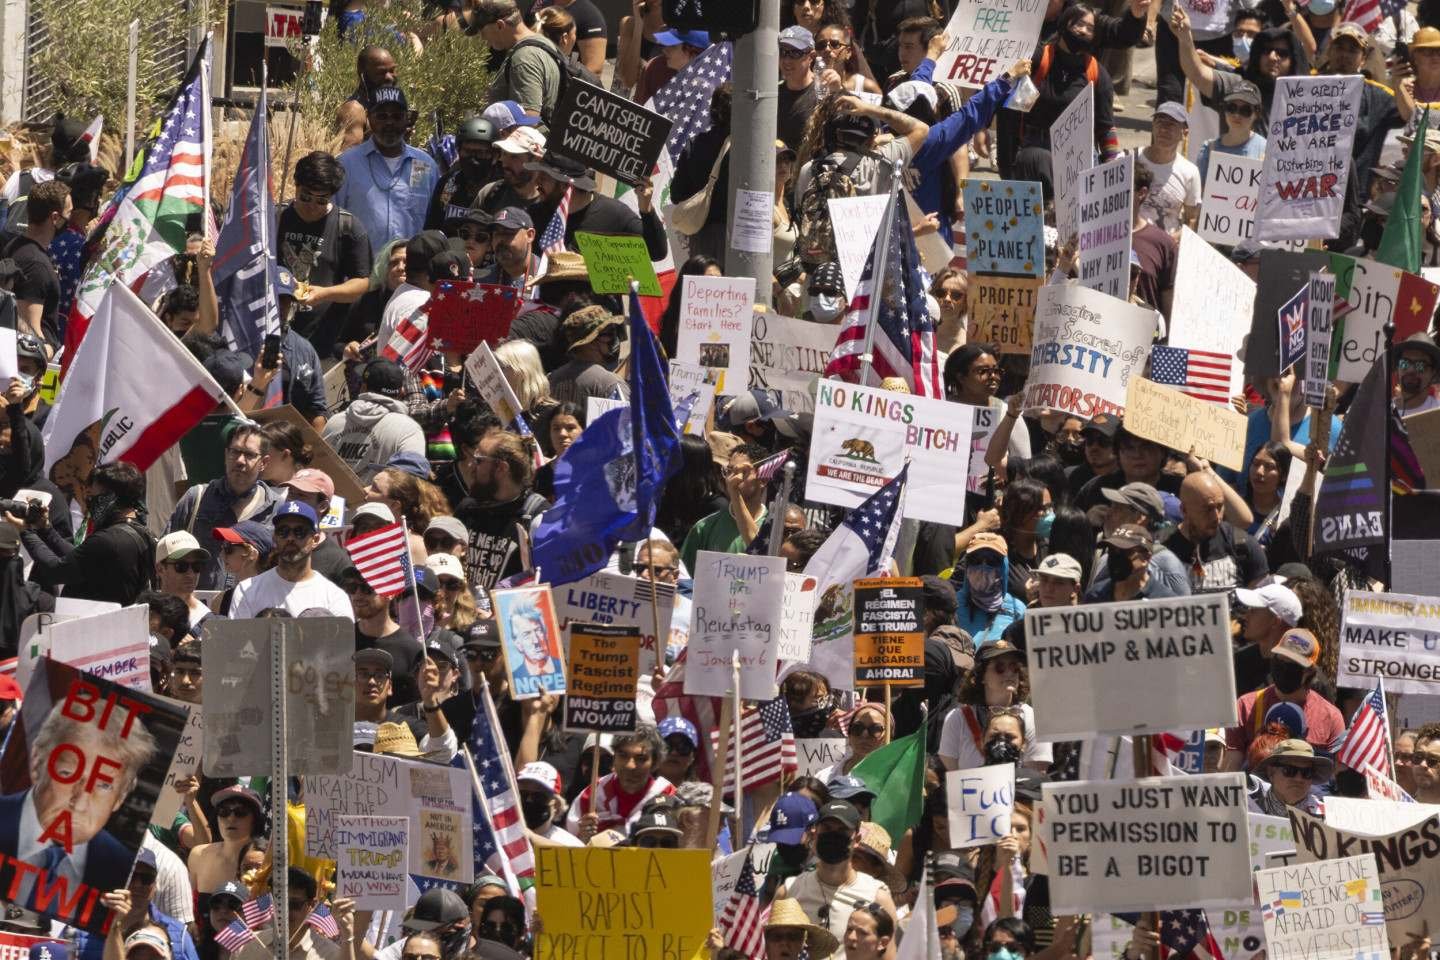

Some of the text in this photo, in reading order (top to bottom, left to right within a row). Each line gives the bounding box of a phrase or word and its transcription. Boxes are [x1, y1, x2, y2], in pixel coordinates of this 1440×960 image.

[1286, 82, 1306, 98] We
[1287, 101, 1351, 116] Disturbing the
[566, 111, 643, 156] COWARDICE
[617, 109, 650, 139] SPELL
[1283, 115, 1341, 136] PEACE
[1278, 136, 1337, 151] We ARE
[564, 132, 648, 178] WITHOUT ICE!
[1278, 159, 1344, 173] Disturbing the
[1275, 174, 1338, 199] WAR
[975, 196, 1034, 217] PEOPLE
[978, 238, 1035, 260] PLANET
[688, 281, 748, 304] Deporting
[979, 286, 1034, 308] PROFIT
[688, 304, 744, 320] Families?
[720, 320, 743, 331] Here
[991, 324, 1018, 343] EGO
[820, 386, 915, 425] NO KINGS
[906, 424, 959, 453] BITCH
[865, 598, 916, 611] RÉGIMEN
[862, 622, 918, 632] DE TRUMP
[863, 611, 917, 622] FASCISTA
[1031, 603, 1219, 637] IF YOU SUPPORT
[871, 635, 905, 645] TIENE
[1346, 627, 1406, 649] MAKE
[859, 655, 920, 665] LARGARSE
[879, 645, 901, 656] QUE
[1034, 632, 1213, 668] TRUMP & MAGA
[866, 668, 914, 680] AHORA!
[61, 680, 152, 740] BIT
[47, 742, 121, 794] OF
[1052, 785, 1243, 815] YOU JUST WANT
[37, 810, 73, 854] A
[1052, 820, 1237, 843] PERMISSION TO
[540, 848, 668, 889] ELECT A
[1058, 854, 1210, 878] BE A BIGOT
[580, 892, 657, 931] RAPIST
